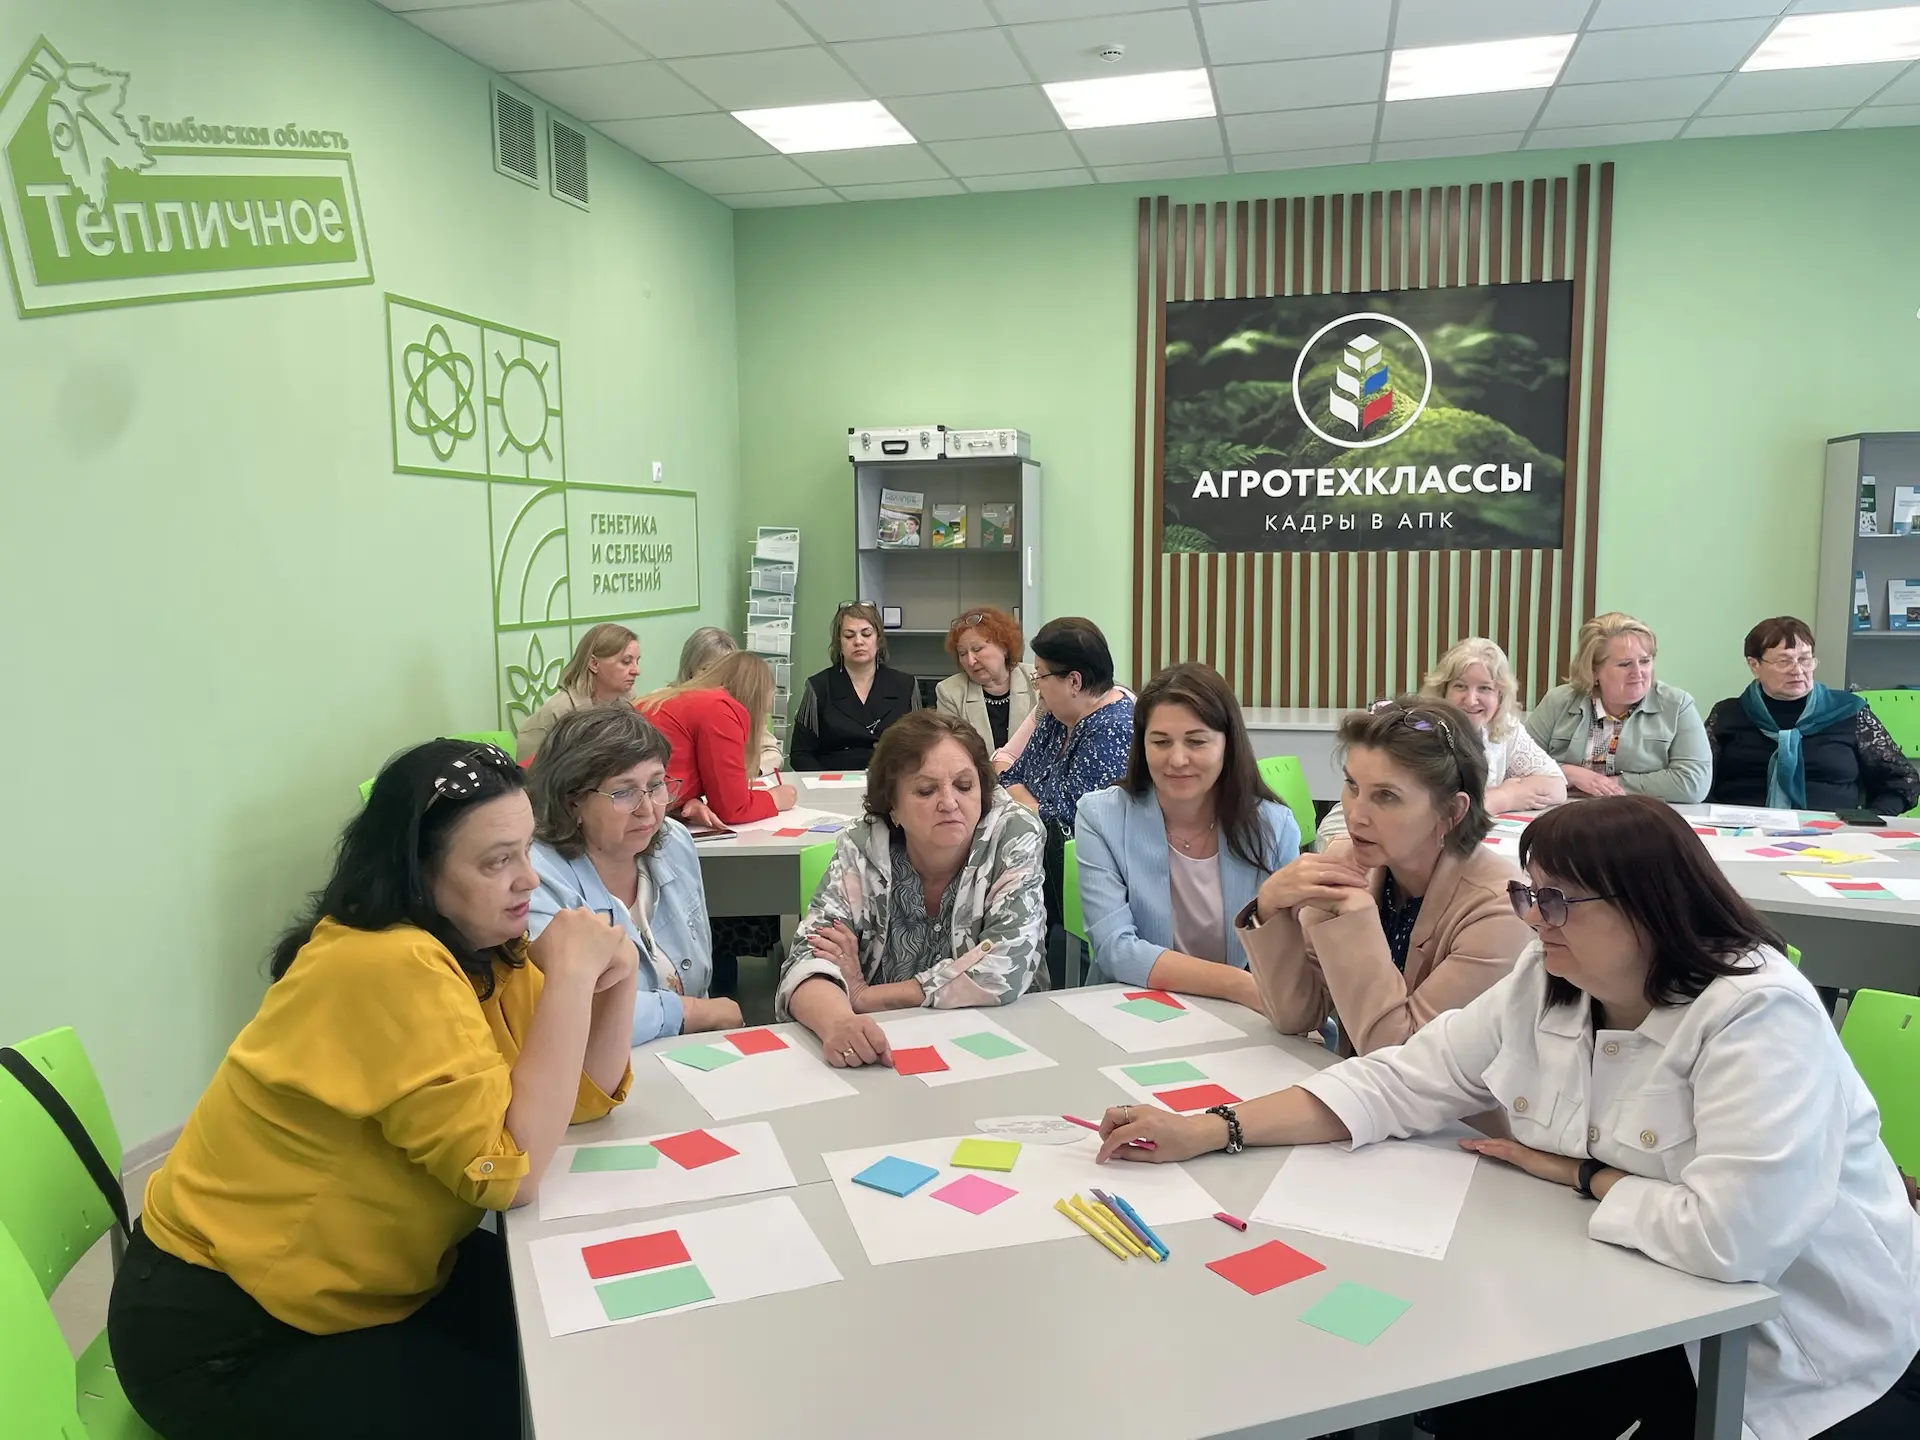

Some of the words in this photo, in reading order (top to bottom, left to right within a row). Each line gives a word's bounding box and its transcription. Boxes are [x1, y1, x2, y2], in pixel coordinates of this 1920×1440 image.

[138, 114, 269, 146] Тамбовская
[274, 122, 349, 149] область
[26, 181, 345, 257] Тепличное
[1191, 462, 1533, 500] АГРОТЕХКЛАССЫ
[590, 513, 658, 535] ГЕНЕТИКА
[1265, 514, 1355, 533] КАДРЫ
[1371, 513, 1383, 530] В
[1397, 511, 1454, 530] АПК
[591, 543, 601, 564] И
[606, 543, 673, 566] СЕЛЕКЦИЯ
[592, 566, 661, 595] РАСТЕНИЙ
